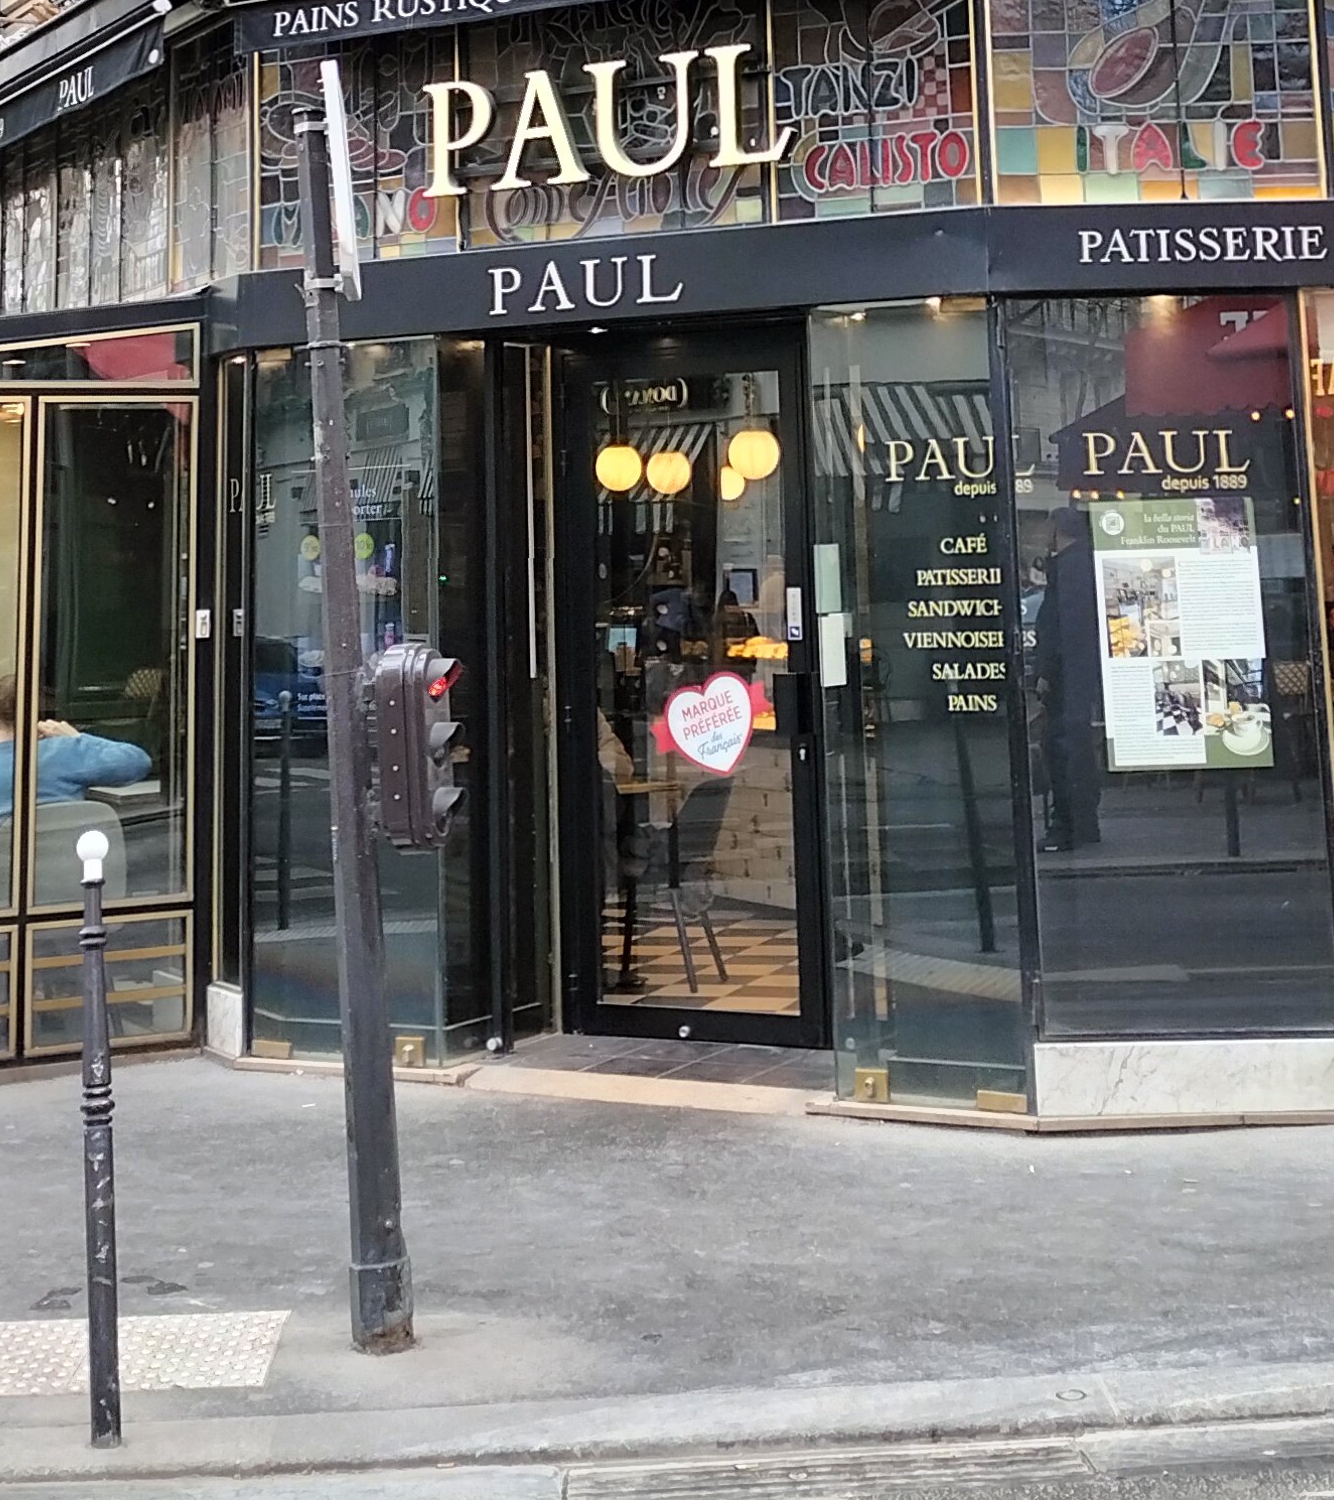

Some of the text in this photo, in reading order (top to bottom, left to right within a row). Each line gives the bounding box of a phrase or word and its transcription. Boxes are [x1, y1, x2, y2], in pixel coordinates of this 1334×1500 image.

[272, 1, 360, 37] PAINS
[57, 65, 95, 112] PAUL
[422, 42, 799, 200] PAUL
[804, 130, 969, 194] CALISTO
[1075, 116, 1267, 176] ITALIE
[1077, 224, 1329, 262] PATISSERIE
[488, 254, 684, 316] PAUL
[1081, 429, 1251, 476] PAUL
[954, 479, 997, 499] depuis
[1161, 473, 1248, 493] depuis 1889
[939, 532, 988, 554] CAFÉ
[1120, 534, 1196, 545] Franklin Roosevelt
[1170, 523, 1195, 533] PAUL
[681, 690, 734, 723] MARQUE
[947, 694, 998, 712] PAINS
[682, 705, 743, 741] PRÉFÉRÉE
[697, 734, 742, 760] Français
